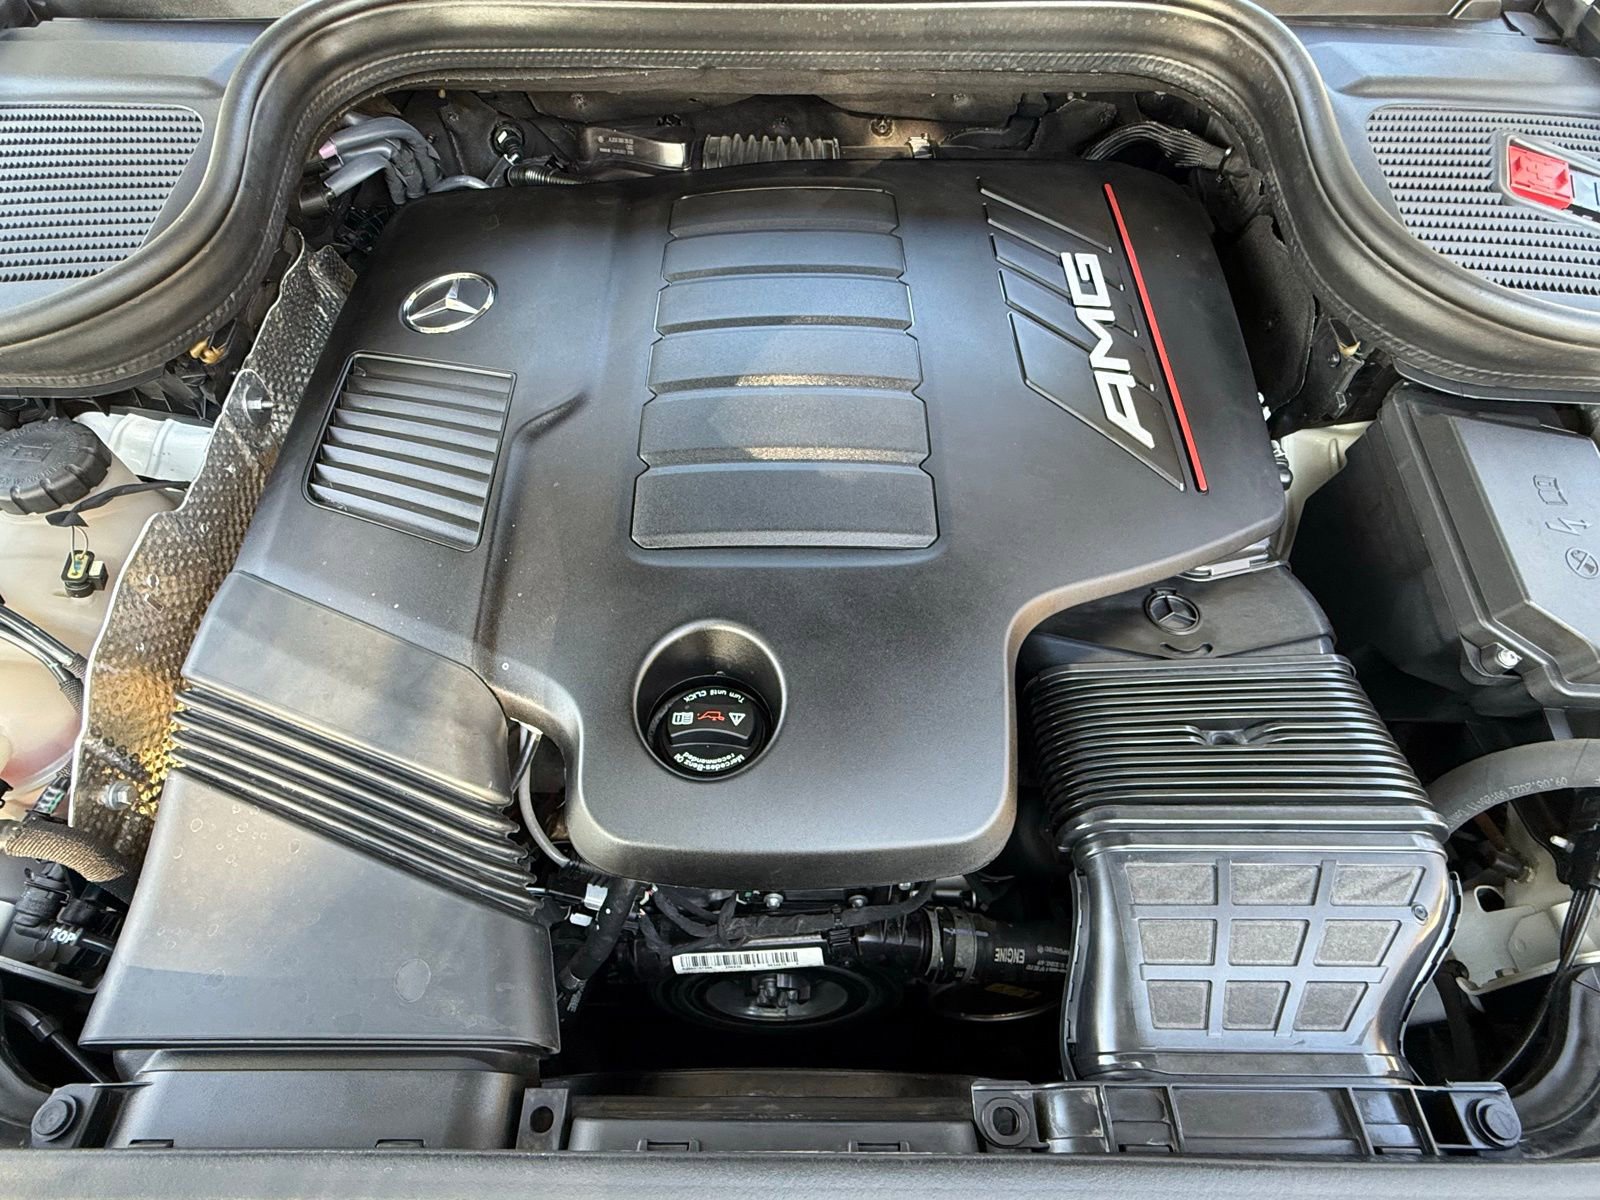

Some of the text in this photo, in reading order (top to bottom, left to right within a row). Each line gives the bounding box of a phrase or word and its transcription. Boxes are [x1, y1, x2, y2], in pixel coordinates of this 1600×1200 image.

[1060, 252, 1155, 448] AMG
[683, 690, 707, 703] CLICK
[729, 691, 745, 703] Turn
[683, 752, 735, 764] recommended
[684, 754, 745, 771] Mercedes-Benz
[51, 927, 77, 944] TOP
[994, 947, 1025, 964] ENGINE
